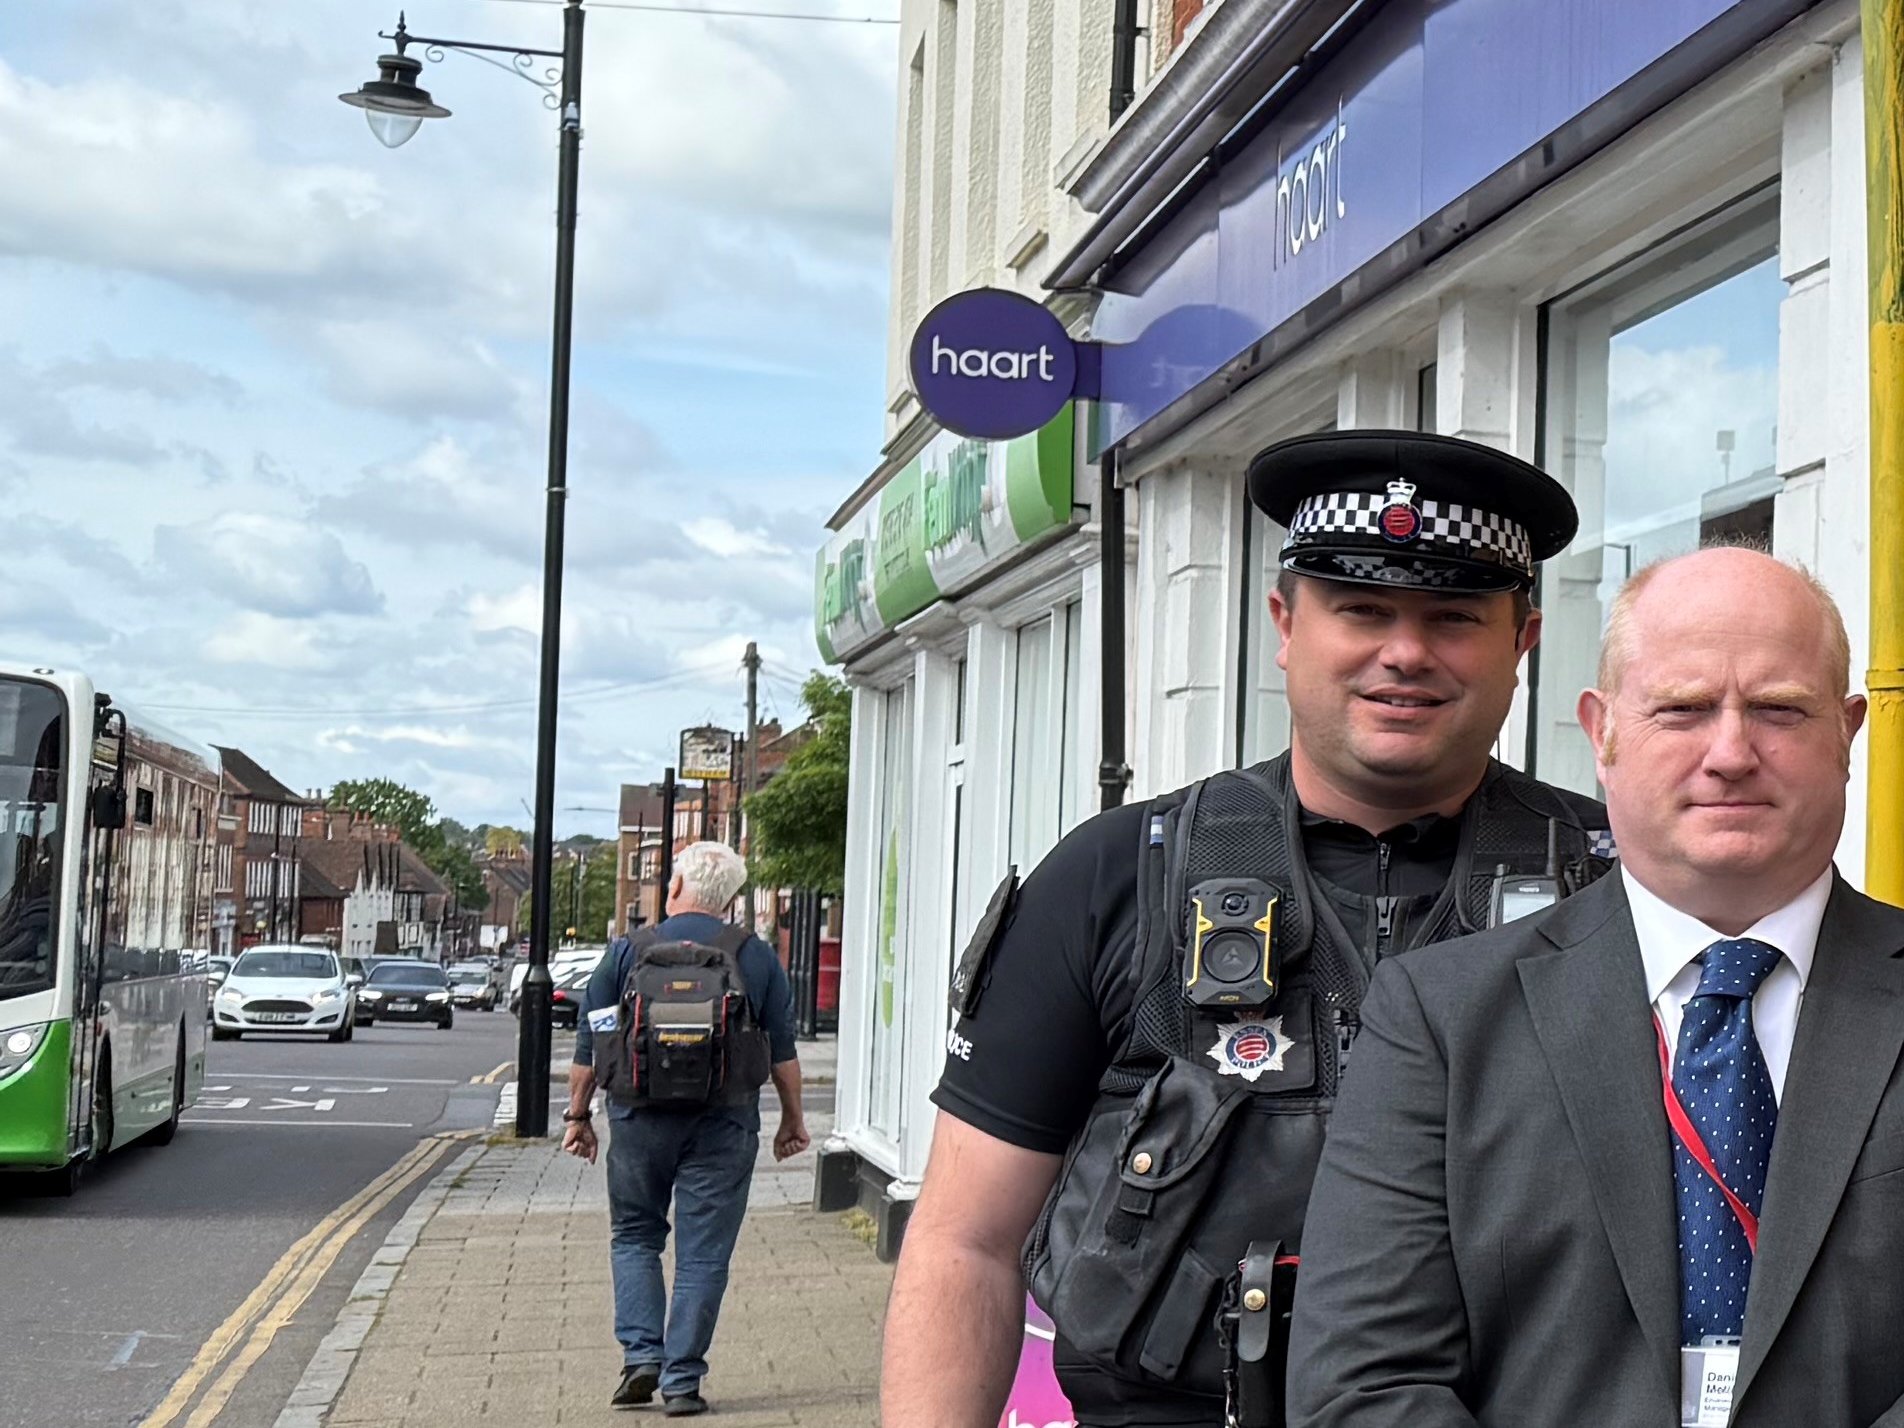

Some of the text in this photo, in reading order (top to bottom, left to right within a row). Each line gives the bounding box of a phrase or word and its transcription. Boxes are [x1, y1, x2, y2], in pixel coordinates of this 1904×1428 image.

[1273, 92, 1346, 271] haart
[932, 335, 1054, 381] haart
[1707, 1372, 1735, 1382] Dani
